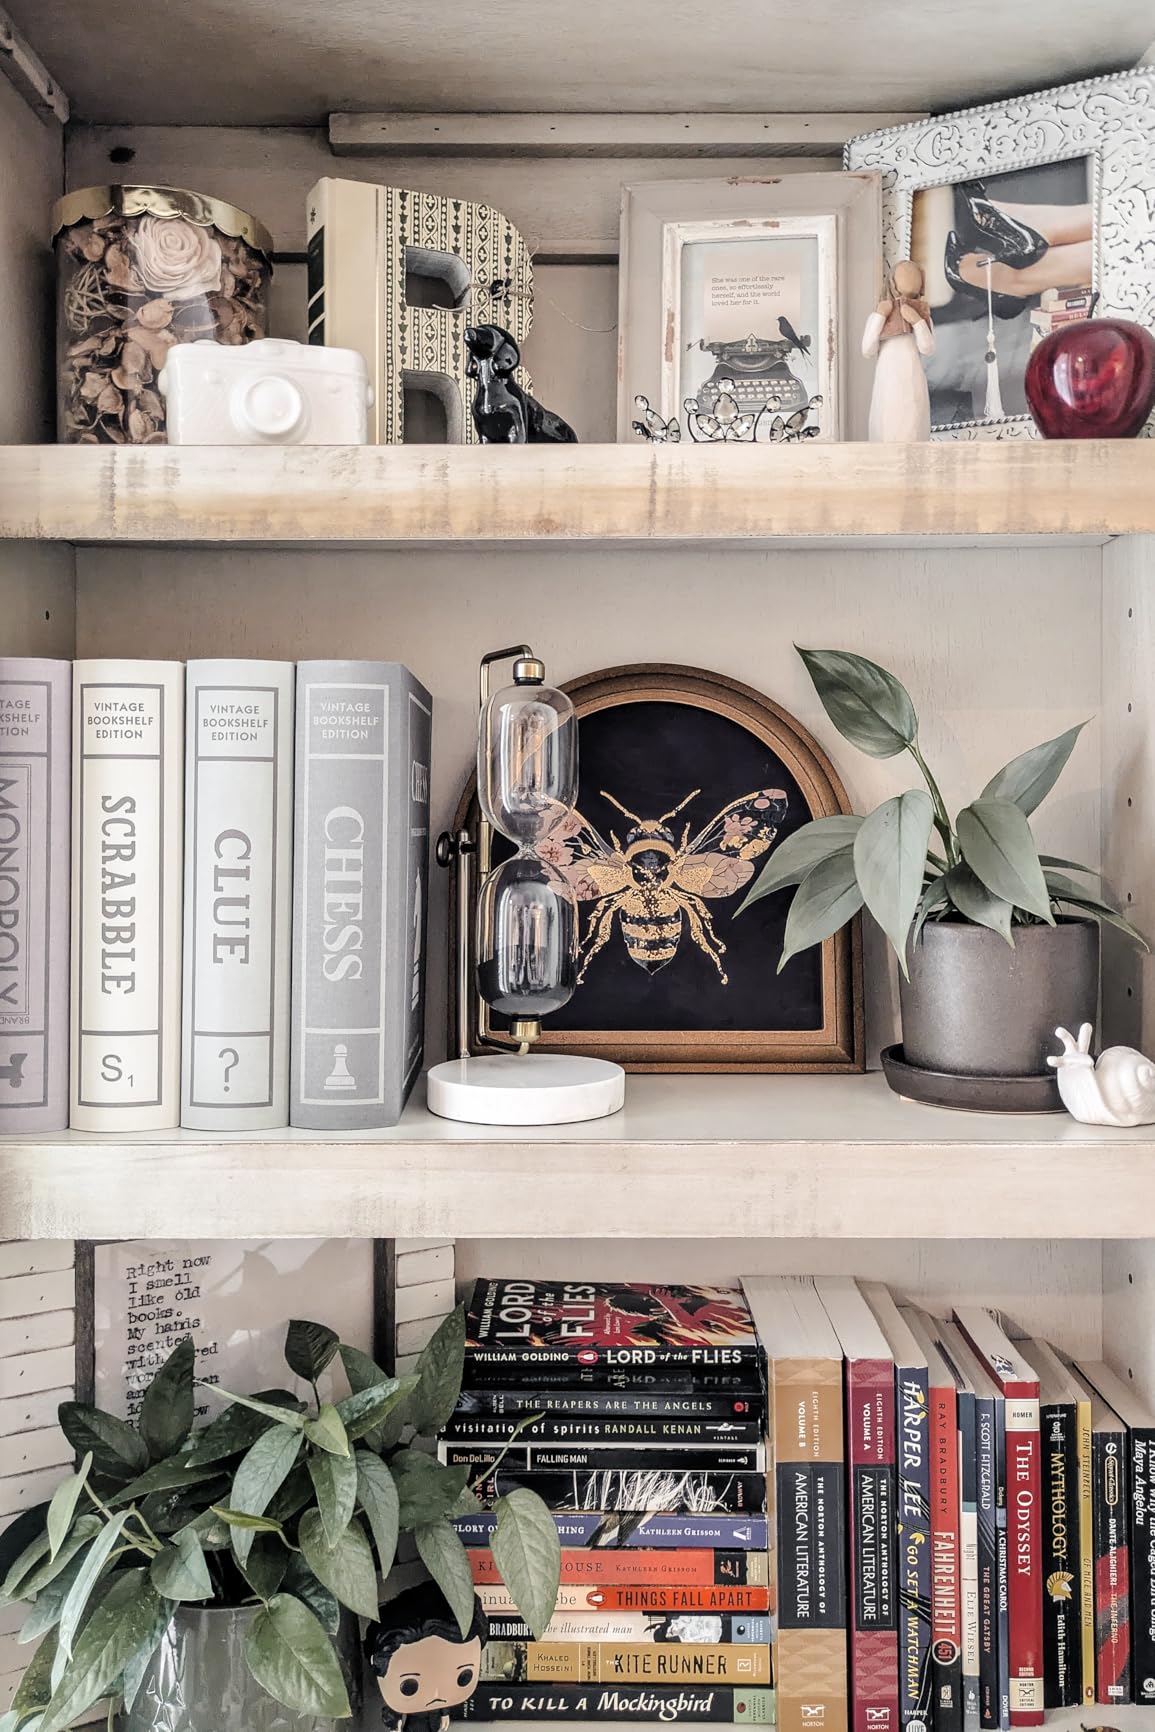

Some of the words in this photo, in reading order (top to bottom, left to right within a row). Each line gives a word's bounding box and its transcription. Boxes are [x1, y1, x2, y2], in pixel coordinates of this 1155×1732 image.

[712, 292, 736, 300] herself,
[94, 702, 144, 712] VINTAGE
[210, 704, 260, 714] VINTAGE
[320, 702, 371, 713] VINTAGE
[87, 716, 154, 726] BOOKSHELF
[96, 729, 143, 739] EDITION
[203, 718, 269, 728] BOOKSHELF
[313, 716, 380, 726] BOOKSHELF
[211, 732, 258, 742] EDITION
[322, 730, 368, 740] EDITION
[101, 795, 136, 995] SCRABBLE
[212, 828, 252, 965] CLUE
[322, 806, 365, 982] CHESS
[218, 1048, 240, 1092] ?
[126, 1259, 174, 1280] Right
[182, 1256, 211, 1269] now
[128, 1282, 138, 1294] I
[146, 1273, 192, 1290] smell
[484, 1282, 499, 1308] GOLDING
[128, 1294, 164, 1309] like
[175, 1286, 200, 1301] old
[496, 1282, 536, 1338] LORD
[538, 1292, 556, 1310] the
[560, 1284, 596, 1337] FLIES
[128, 1307, 182, 1324] books.
[478, 1308, 494, 1339] WILLIAM
[537, 1309, 557, 1323] of
[127, 1327, 146, 1341] My
[155, 1318, 200, 1334] hands
[127, 1332, 191, 1355] scented
[473, 1353, 517, 1362] WILLIAM
[521, 1352, 570, 1362] GOLDING
[607, 1350, 656, 1364] LORD
[659, 1352, 671, 1362] of
[672, 1351, 688, 1361] the
[692, 1350, 742, 1364] FLIES
[516, 1400, 541, 1409] THE
[547, 1400, 599, 1409] REAPERS
[605, 1400, 628, 1410] ARE
[634, 1401, 658, 1410] THE
[664, 1401, 712, 1410] ANGELS
[938, 1402, 946, 1430] RAY
[980, 1413, 990, 1421] F.
[454, 1422, 524, 1433] visitation
[531, 1422, 546, 1433] of
[553, 1422, 600, 1436] spirits
[604, 1424, 656, 1434] RANDALL
[662, 1424, 701, 1434] KENAN
[798, 1401, 806, 1438] VOLUME
[863, 1402, 871, 1441] VOLUME
[904, 1380, 922, 1469] HARPER
[812, 1424, 820, 1457] EDITION
[876, 1426, 884, 1460] EDITION
[981, 1422, 990, 1450] SCOTT
[1082, 1427, 1090, 1451] JOHN
[452, 1454, 469, 1463] Don
[469, 1454, 496, 1463] DeLillo
[536, 1454, 568, 1464] FALLING
[569, 1454, 588, 1464] MAN
[1016, 1440, 1033, 1482] THE
[1134, 1439, 1146, 1474] Maya
[939, 1438, 948, 1515] BRADBURY
[981, 1454, 991, 1510] FITZGERALD
[1082, 1454, 1090, 1499] STEINBECK
[794, 1472, 809, 1541] AMERICAN
[861, 1474, 875, 1544] AMERICAN
[904, 1480, 922, 1518] LEE
[1050, 1453, 1067, 1560] MYTHOLOGY
[1133, 1474, 1147, 1526] Angelou
[453, 1524, 484, 1532] GLORY
[639, 1527, 682, 1536] KATHLEEN
[684, 1527, 721, 1536] GRISSOM
[817, 1498, 825, 1537] NORTON
[880, 1500, 888, 1539] NORTON
[1016, 1490, 1034, 1577] ODYSSEY
[1108, 1518, 1117, 1544] DANTE
[906, 1545, 918, 1565] GO
[998, 1536, 1007, 1584] CHRISTMAS
[1083, 1558, 1092, 1569] OF
[1109, 1545, 1118, 1586] ALIGHIERI
[615, 1564, 658, 1572] KATHLEEN
[661, 1565, 698, 1573] GRISSOM
[795, 1545, 810, 1618] LITERATURE
[818, 1540, 826, 1598] ANTHOLOGY
[880, 1543, 889, 1600] ANTHOLOGY
[1083, 1570, 1093, 1592] MICE
[862, 1548, 877, 1621] LITERATURE
[906, 1569, 919, 1598] SET
[934, 1531, 956, 1635] FAHRENHEIT
[616, 1591, 667, 1606] THINGS
[673, 1591, 704, 1606] FALL
[710, 1591, 753, 1606] APART
[818, 1601, 826, 1614] OF
[882, 1603, 889, 1616] OF
[906, 1600, 919, 1610] A
[966, 1592, 976, 1617] ELIE
[999, 1585, 1008, 1613] CAROL
[1084, 1593, 1093, 1611] AND
[1110, 1593, 1118, 1608] THE
[560, 1622, 611, 1633] illustrated
[612, 1625, 633, 1634] man
[1056, 1614, 1066, 1640] Edith
[1084, 1612, 1093, 1627] MEN
[1110, 1609, 1118, 1644] INFERNO
[967, 1620, 977, 1664] WIESEL
[983, 1619, 991, 1654] GATSBY
[537, 1653, 569, 1662] KHALED
[907, 1616, 920, 1700] WATCHMAN
[938, 1642, 953, 1659] 451
[533, 1664, 573, 1672] HOSSEINI
[614, 1654, 652, 1674] KITE
[657, 1654, 727, 1675] RUNNER
[1057, 1642, 1067, 1688] Hamilton
[489, 1697, 513, 1710] TO
[520, 1697, 569, 1711] KILL
[575, 1697, 588, 1711] A
[597, 1692, 715, 1721] Mockingbird
